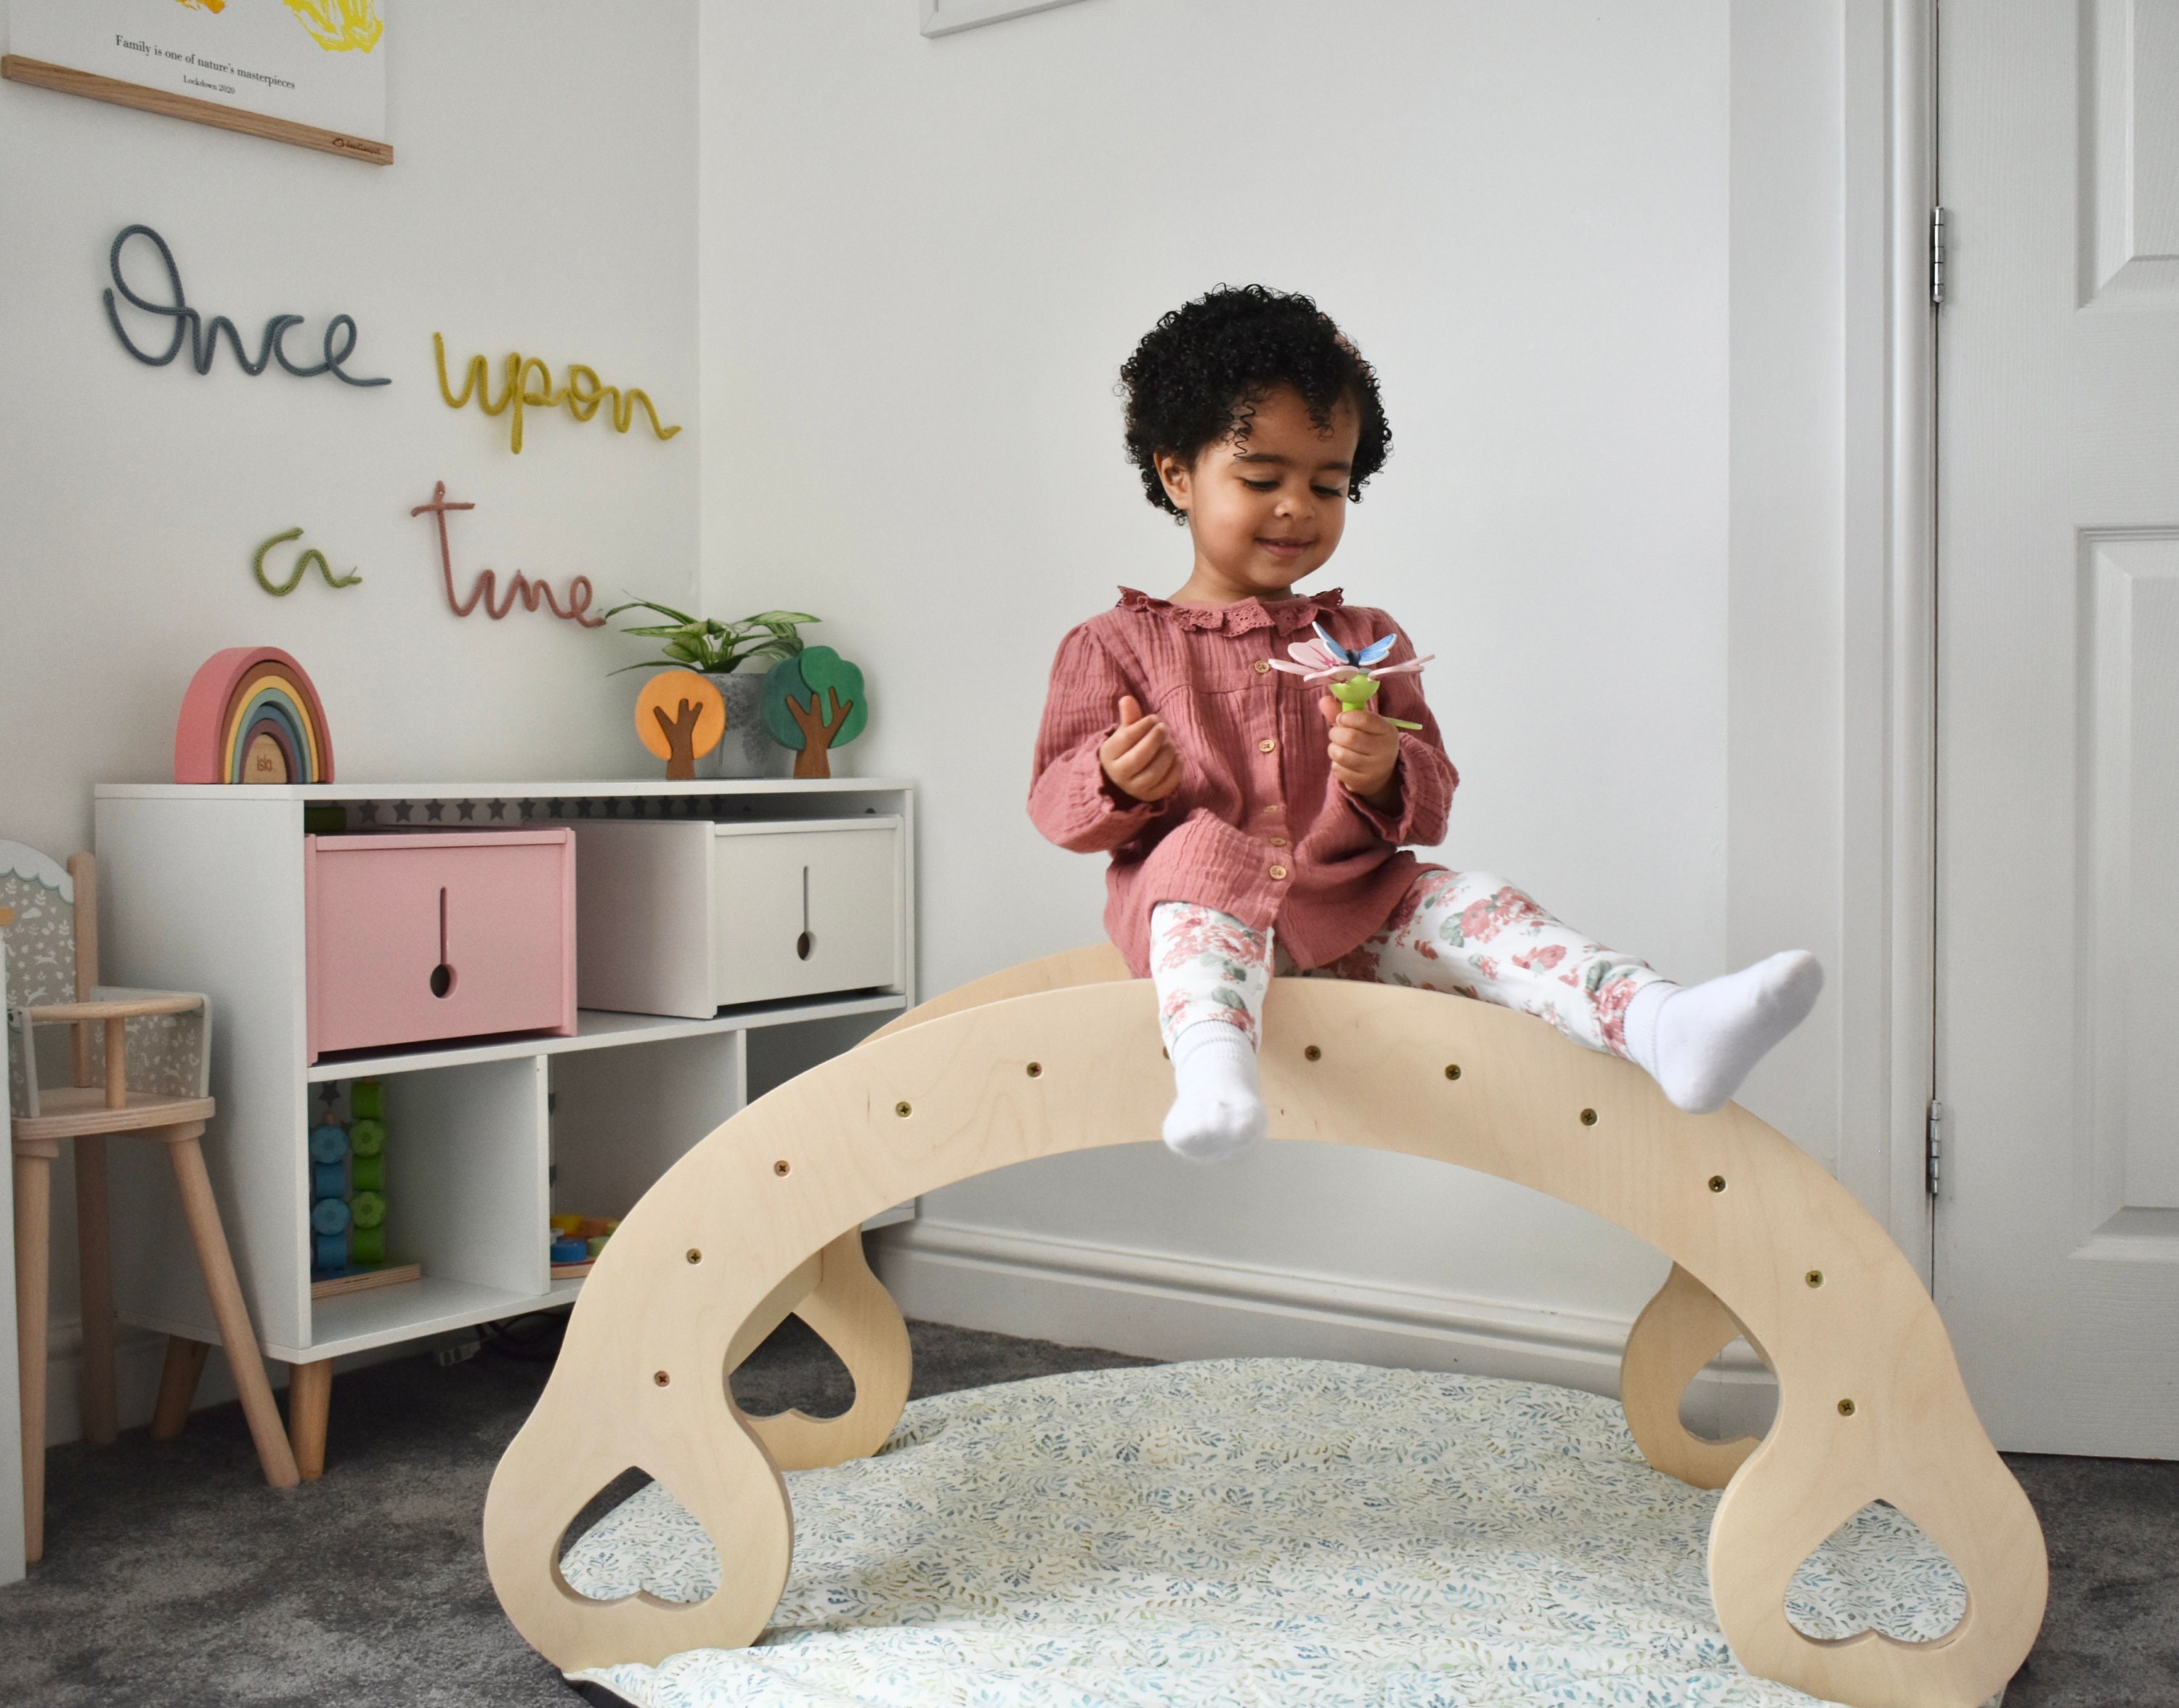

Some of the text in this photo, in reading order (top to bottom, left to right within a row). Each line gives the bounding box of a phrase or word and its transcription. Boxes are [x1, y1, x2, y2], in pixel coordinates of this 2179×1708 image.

[116, 35, 296, 89] Family is one of nature's masterpieces
[183, 75, 235, 94] Lockdown 2020
[103, 224, 682, 455] Once upon
[411, 481, 607, 628] time
